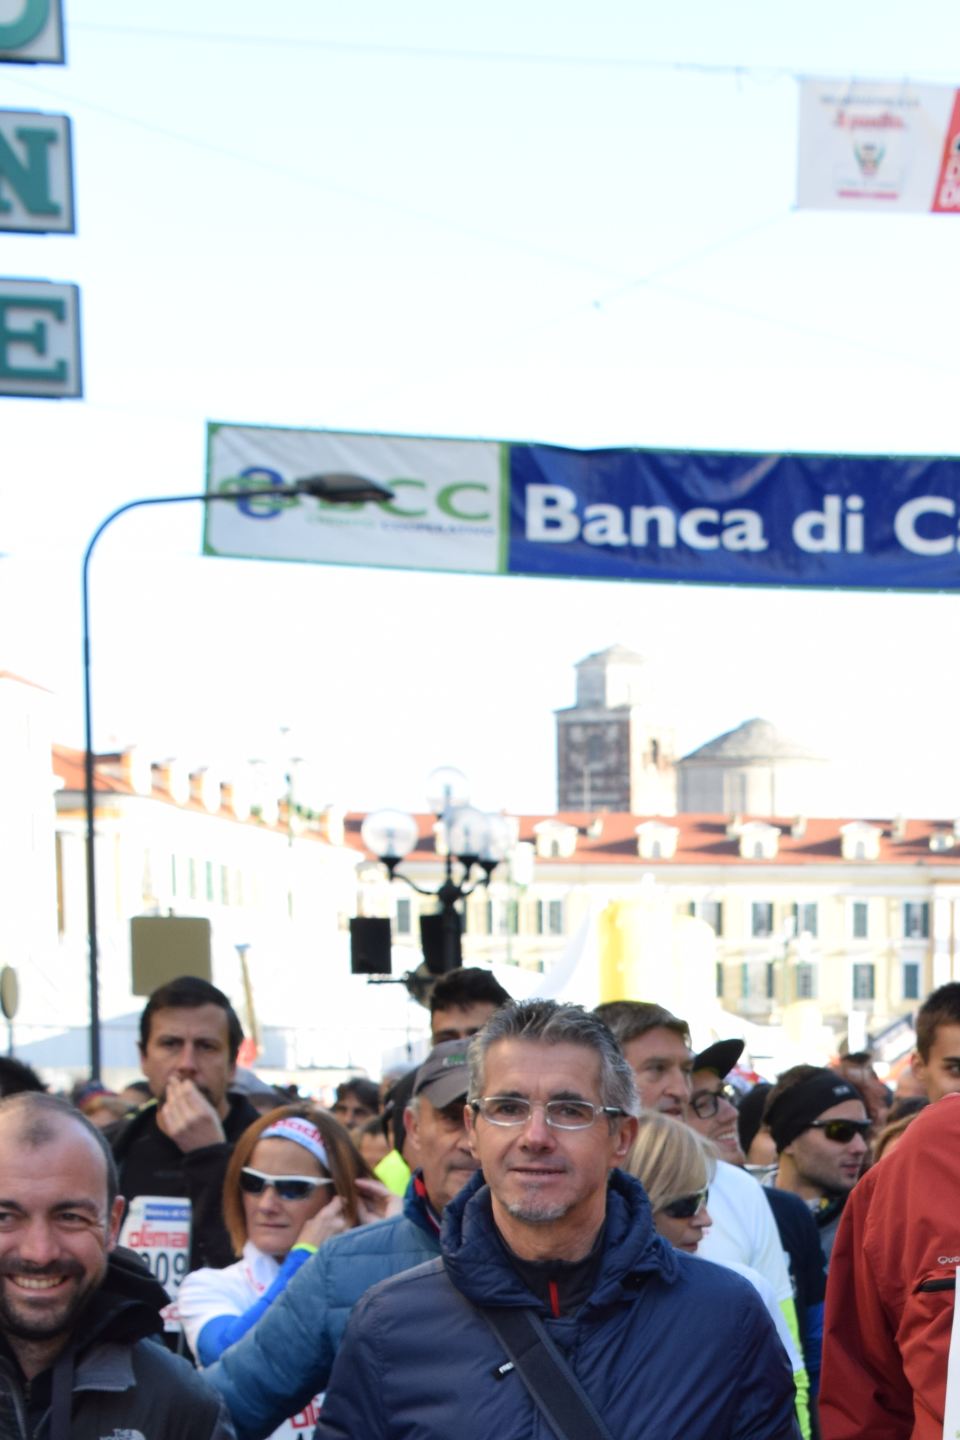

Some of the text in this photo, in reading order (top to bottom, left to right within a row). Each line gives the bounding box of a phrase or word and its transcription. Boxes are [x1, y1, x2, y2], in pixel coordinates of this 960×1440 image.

[318, 477, 491, 521] CC
[525, 484, 768, 552] Banca
[792, 494, 864, 554] di
